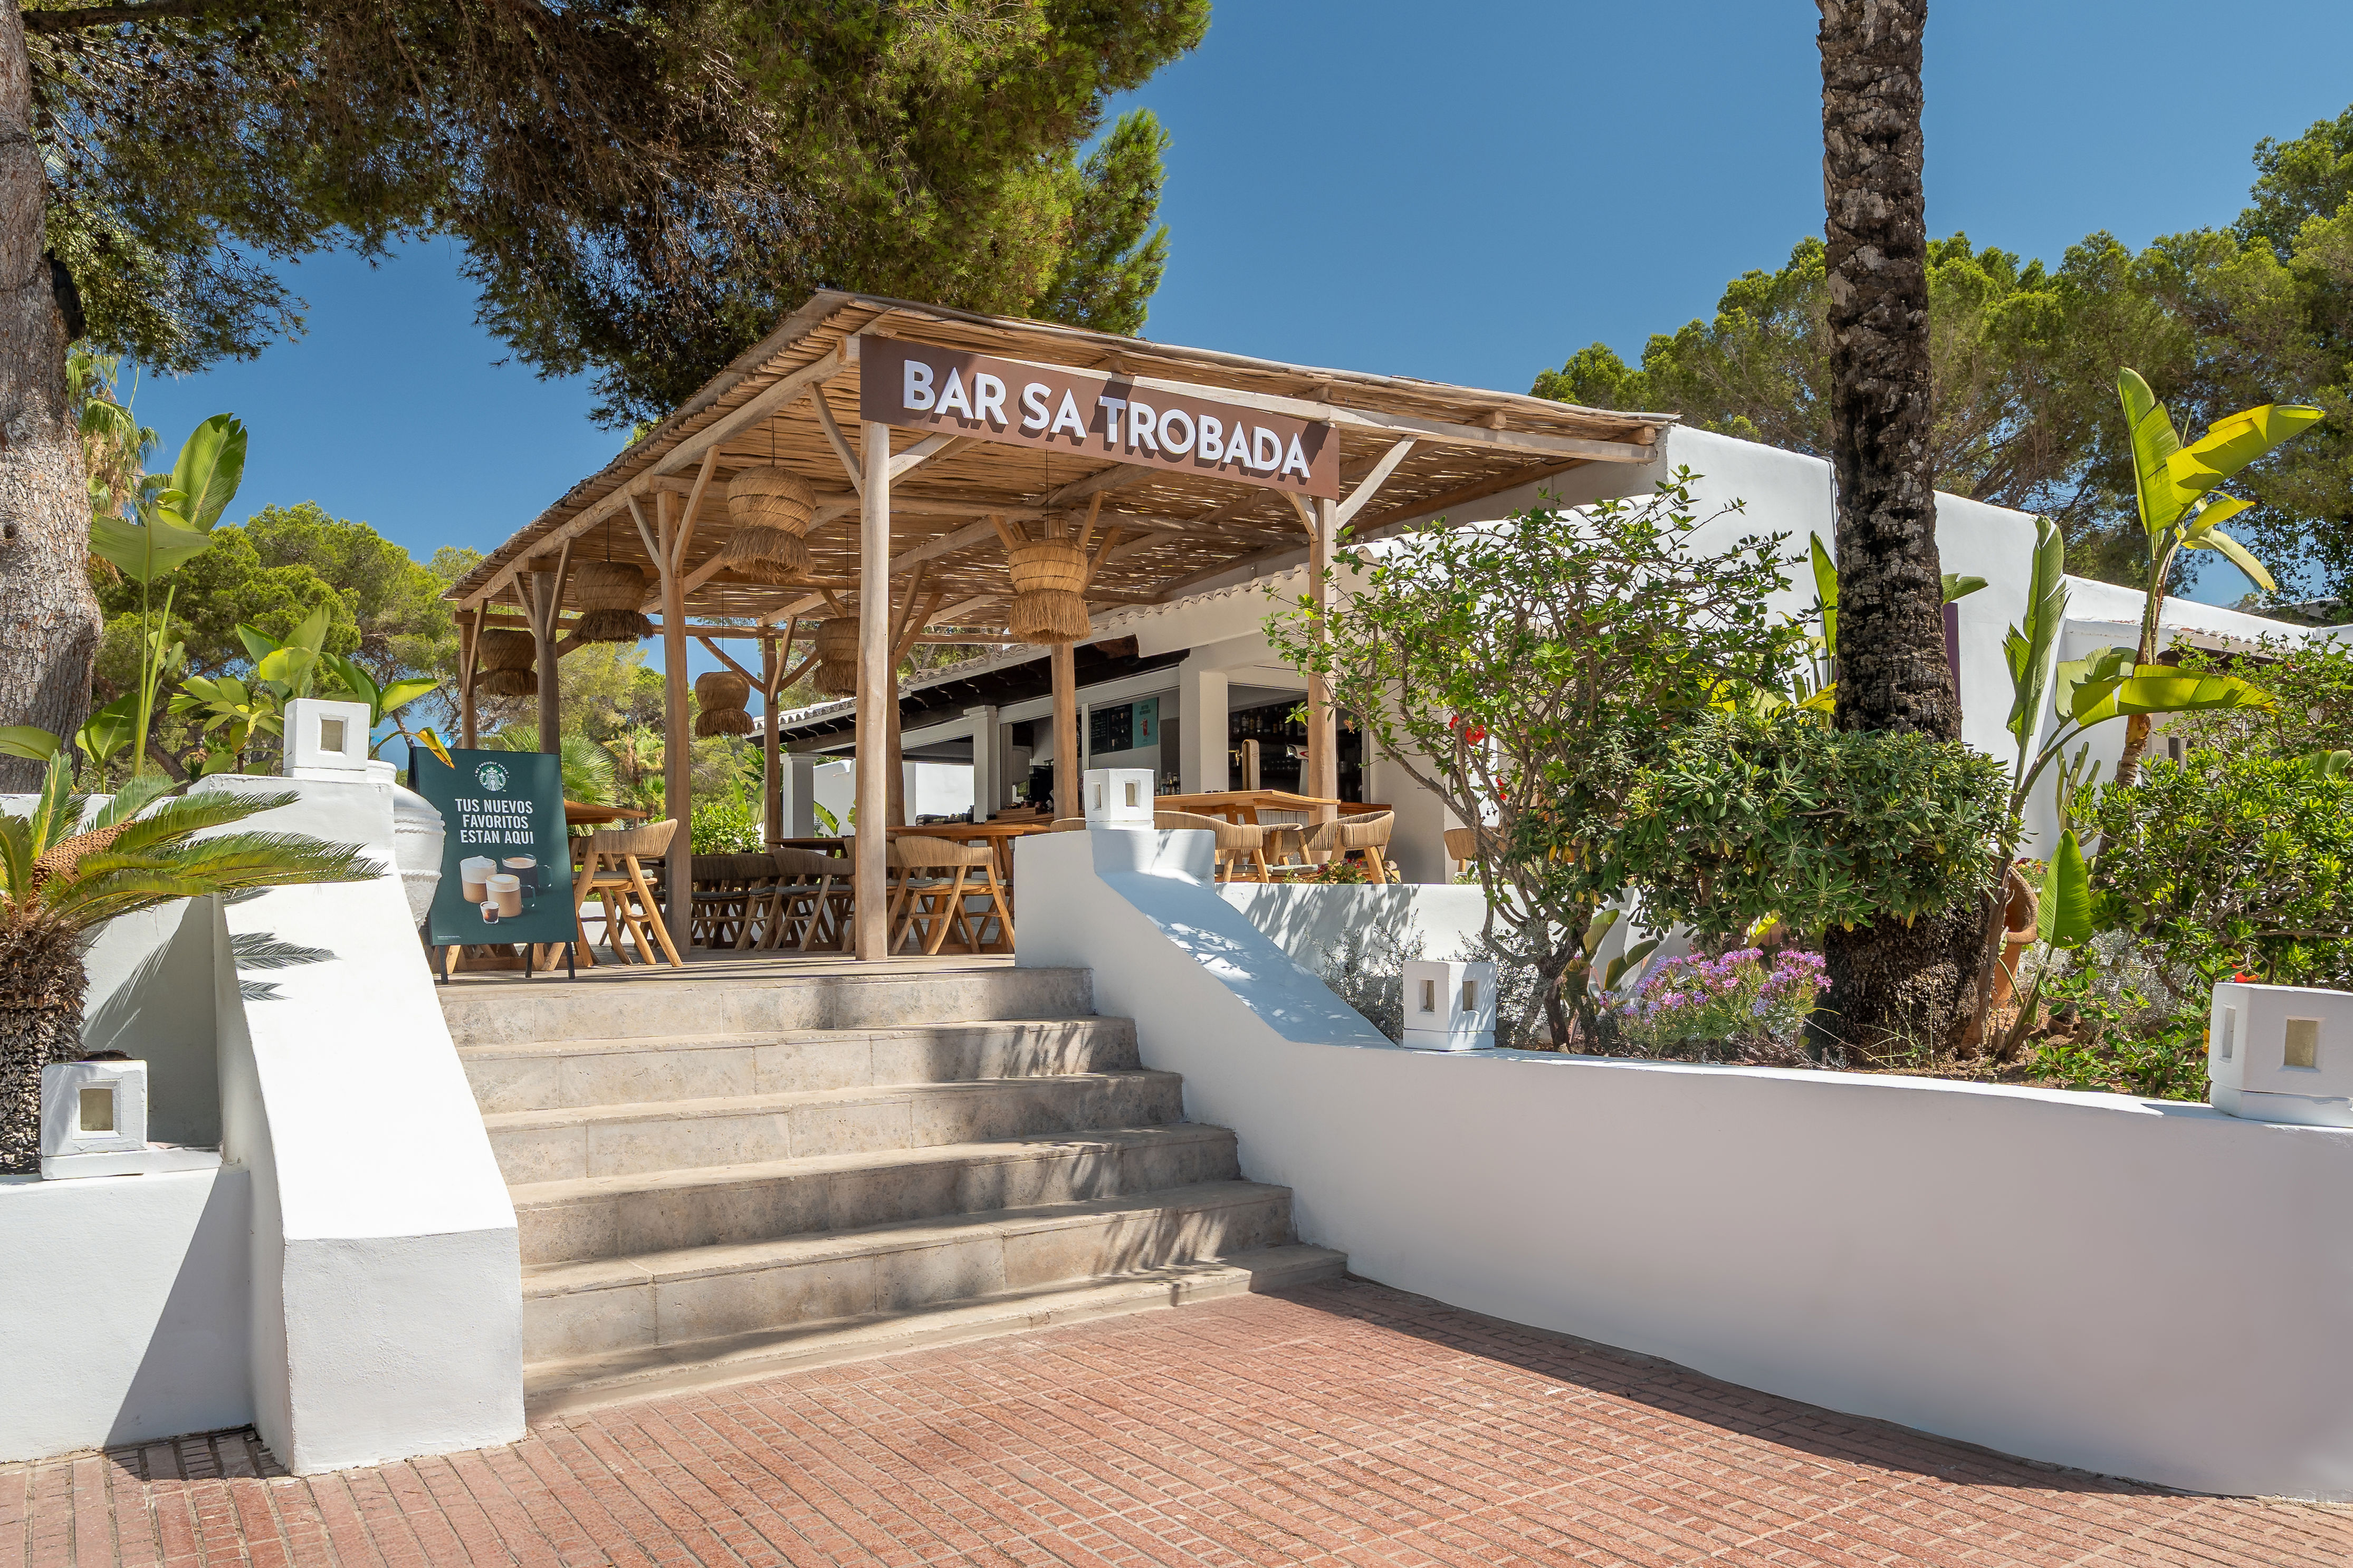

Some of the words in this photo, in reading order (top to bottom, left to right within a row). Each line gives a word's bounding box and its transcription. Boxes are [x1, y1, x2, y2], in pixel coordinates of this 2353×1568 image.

[903, 359, 1009, 426] BAR
[1021, 382, 1087, 440] SA
[1097, 395, 1311, 479] TROBADA
[498, 763, 509, 774] SERVE
[455, 799, 480, 812] TUS
[483, 799, 533, 814] NUEVOS
[462, 814, 529, 829] FAVORITOS
[460, 830, 500, 843] ESTAN
[504, 831, 534, 845] AQUI
